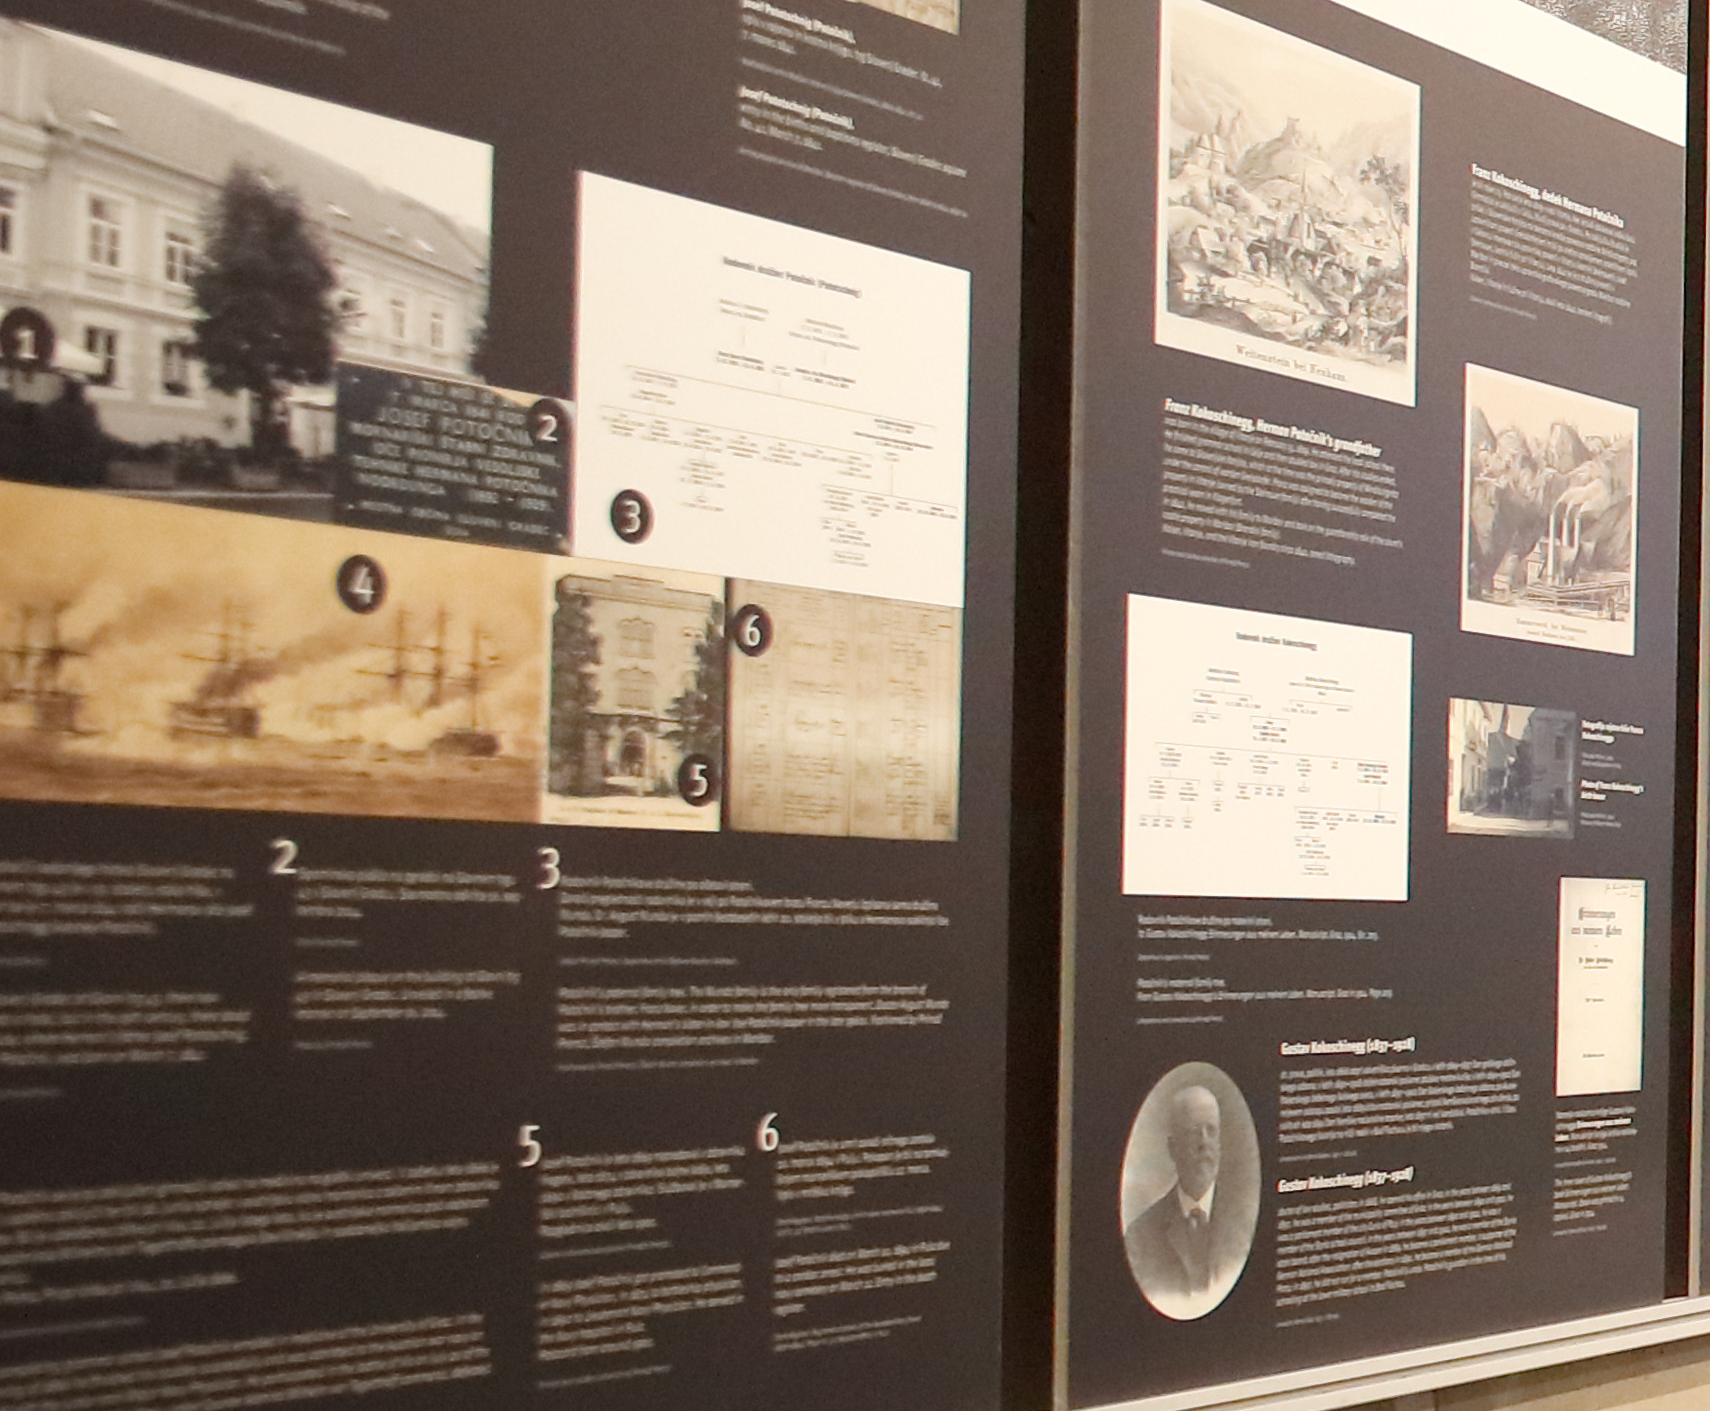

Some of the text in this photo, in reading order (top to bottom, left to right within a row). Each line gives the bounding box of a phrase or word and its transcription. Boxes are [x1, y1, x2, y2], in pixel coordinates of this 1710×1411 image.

[535, 415, 558, 441] 2
[624, 500, 641, 533] 3
[350, 567, 374, 600] 4
[742, 615, 762, 647] 6
[689, 768, 708, 797] 5
[269, 839, 298, 876] 2
[538, 847, 561, 891] 3
[519, 1125, 542, 1168] 5
[756, 1111, 780, 1152] 6
